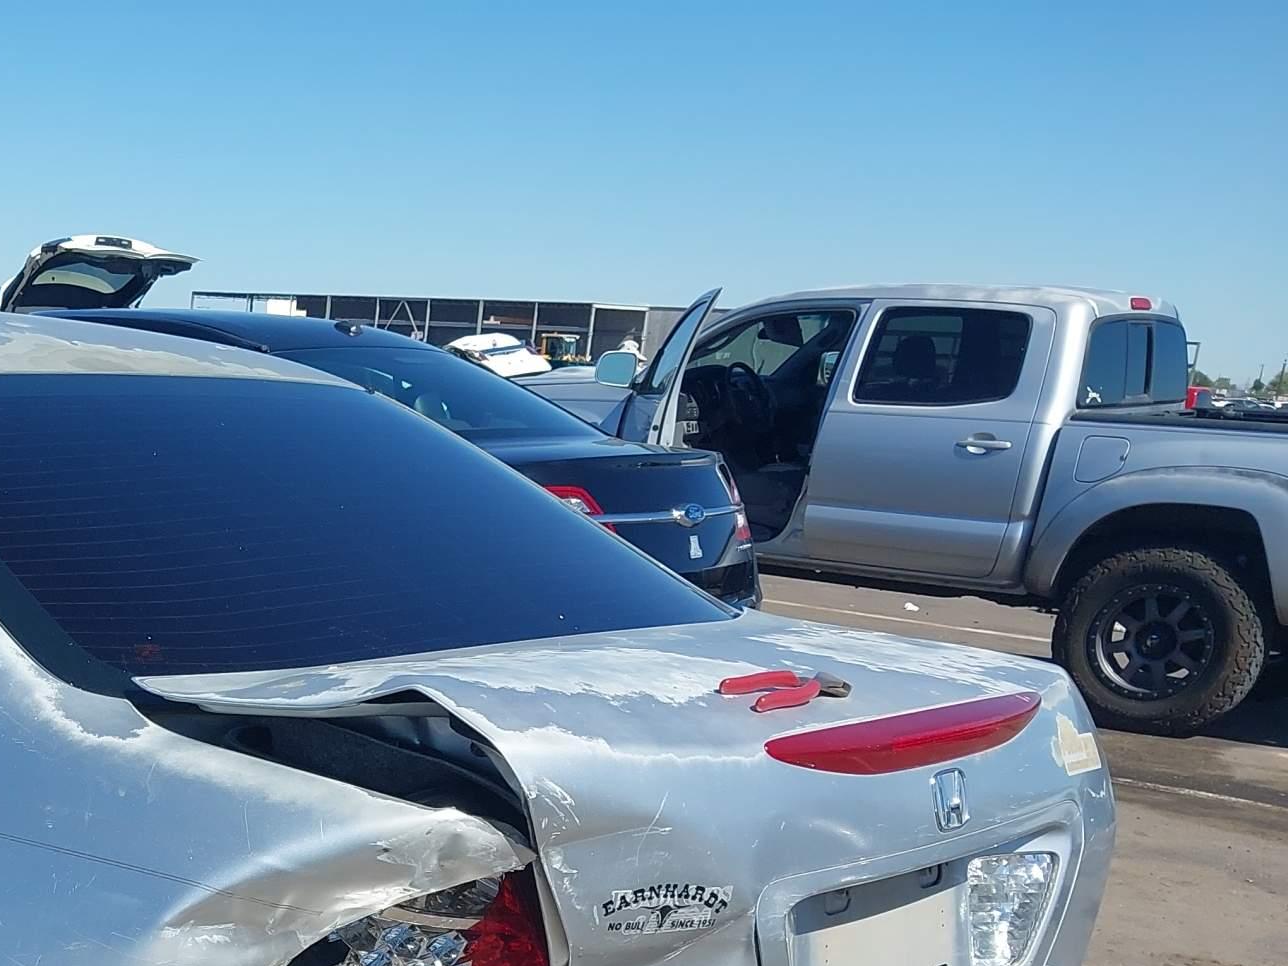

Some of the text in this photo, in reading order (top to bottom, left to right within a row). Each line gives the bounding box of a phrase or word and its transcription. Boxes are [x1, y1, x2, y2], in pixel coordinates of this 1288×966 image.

[602, 883, 729, 917] EARNHARDT
[607, 922, 622, 931] NO
[670, 918, 696, 929] SINCE
[697, 918, 717, 928] 1951
